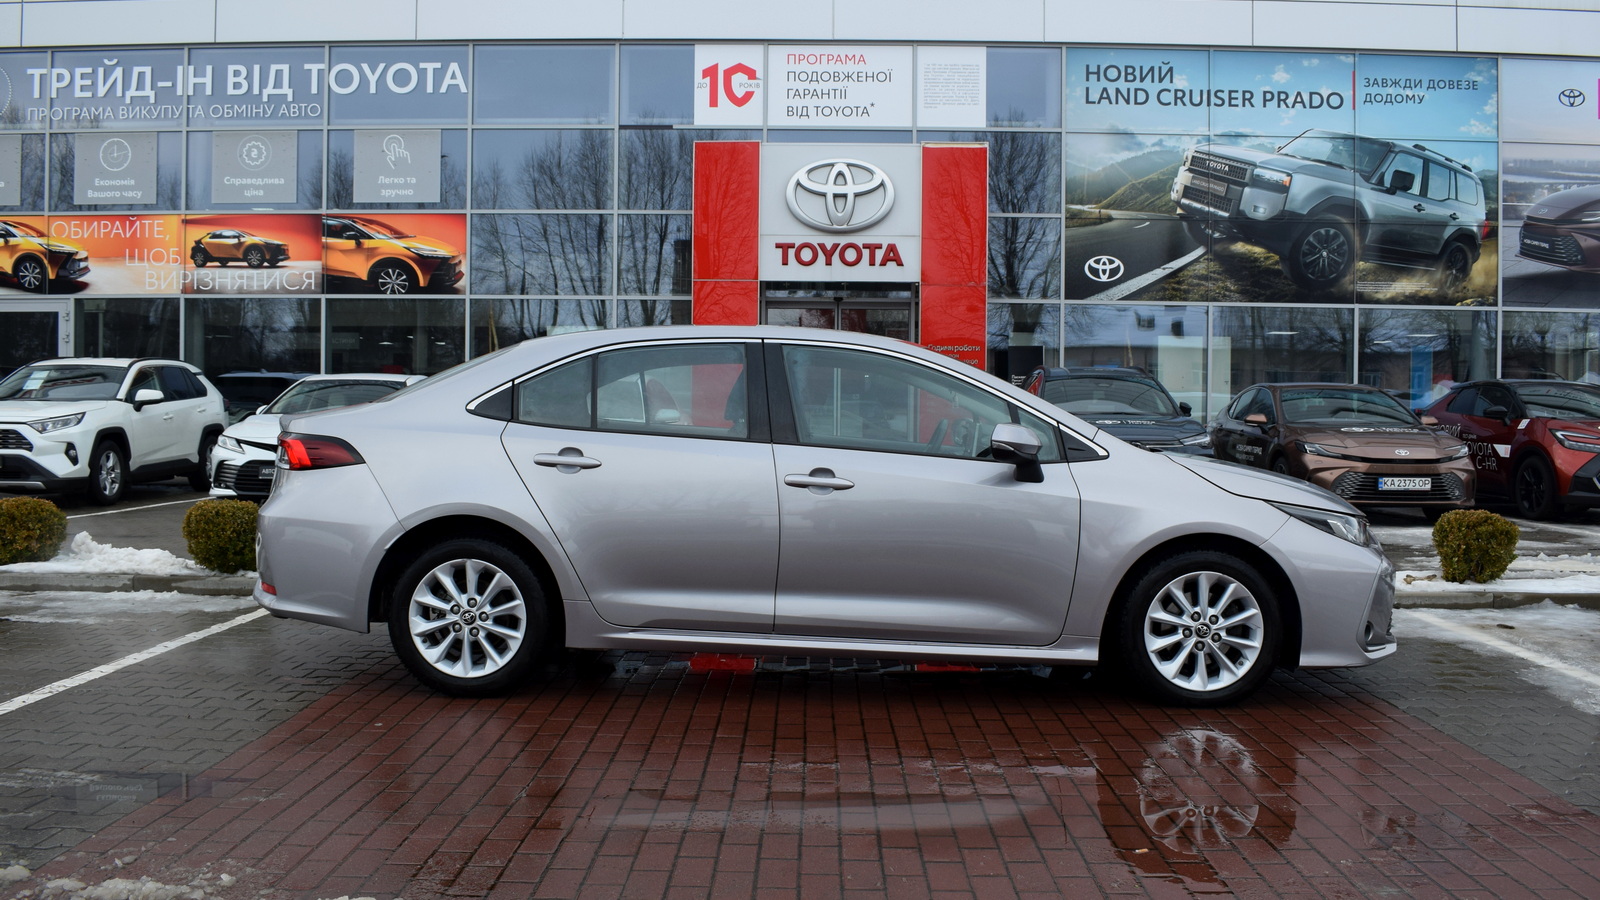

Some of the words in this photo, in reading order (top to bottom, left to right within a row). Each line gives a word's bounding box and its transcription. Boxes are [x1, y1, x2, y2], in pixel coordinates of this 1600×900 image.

[786, 53, 867, 66] ПРОГРАМА
[786, 68, 893, 84] ПОДОВЖЕНОЇ
[1085, 60, 1175, 84] НОВИЙ
[27, 59, 214, 104] ТРЕЙД-ІН
[226, 64, 294, 102] ВІД
[303, 62, 469, 97] TOYOTA
[696, 82, 708, 90] ДО
[701, 62, 758, 108] 10
[738, 81, 761, 90] РОКІВ
[1363, 77, 1424, 92] ЗАВЖДИ
[1426, 79, 1480, 93] ДОВЕЗЕ
[786, 86, 848, 100] ГАРАНТІЇ
[1085, 86, 1150, 107] LAND
[1155, 87, 1256, 109] CRUISER
[1262, 89, 1345, 111] PRADO
[1363, 91, 1426, 106] ДОДОМУ
[27, 106, 115, 122] ПРОГРАМА
[119, 104, 183, 120] ВИКУПУ
[187, 105, 206, 119] ТА
[208, 104, 275, 119] ОБМІНУ
[278, 103, 322, 118] АВТО
[786, 106, 810, 119] ВІД
[1206, 160, 1229, 171] TOYOTA
[94, 176, 136, 188] Економія
[223, 175, 286, 188] Справедлива
[378, 175, 401, 187] Легко
[403, 176, 417, 185] та
[87, 188, 120, 200] Вашого
[122, 189, 143, 200] часу
[244, 187, 265, 198] ціна
[380, 187, 415, 198] зручно
[50, 216, 171, 242] ОБИРАЙТЕ,
[125, 247, 182, 269] ЩОБ
[775, 242, 905, 267] TOYOTA
[145, 270, 317, 291] ВИРІЗНЯТИСЯ
[954, 344, 980, 352] роботи
[1476, 456, 1497, 470] C-HR
[1397, 478, 1417, 488] 2375
